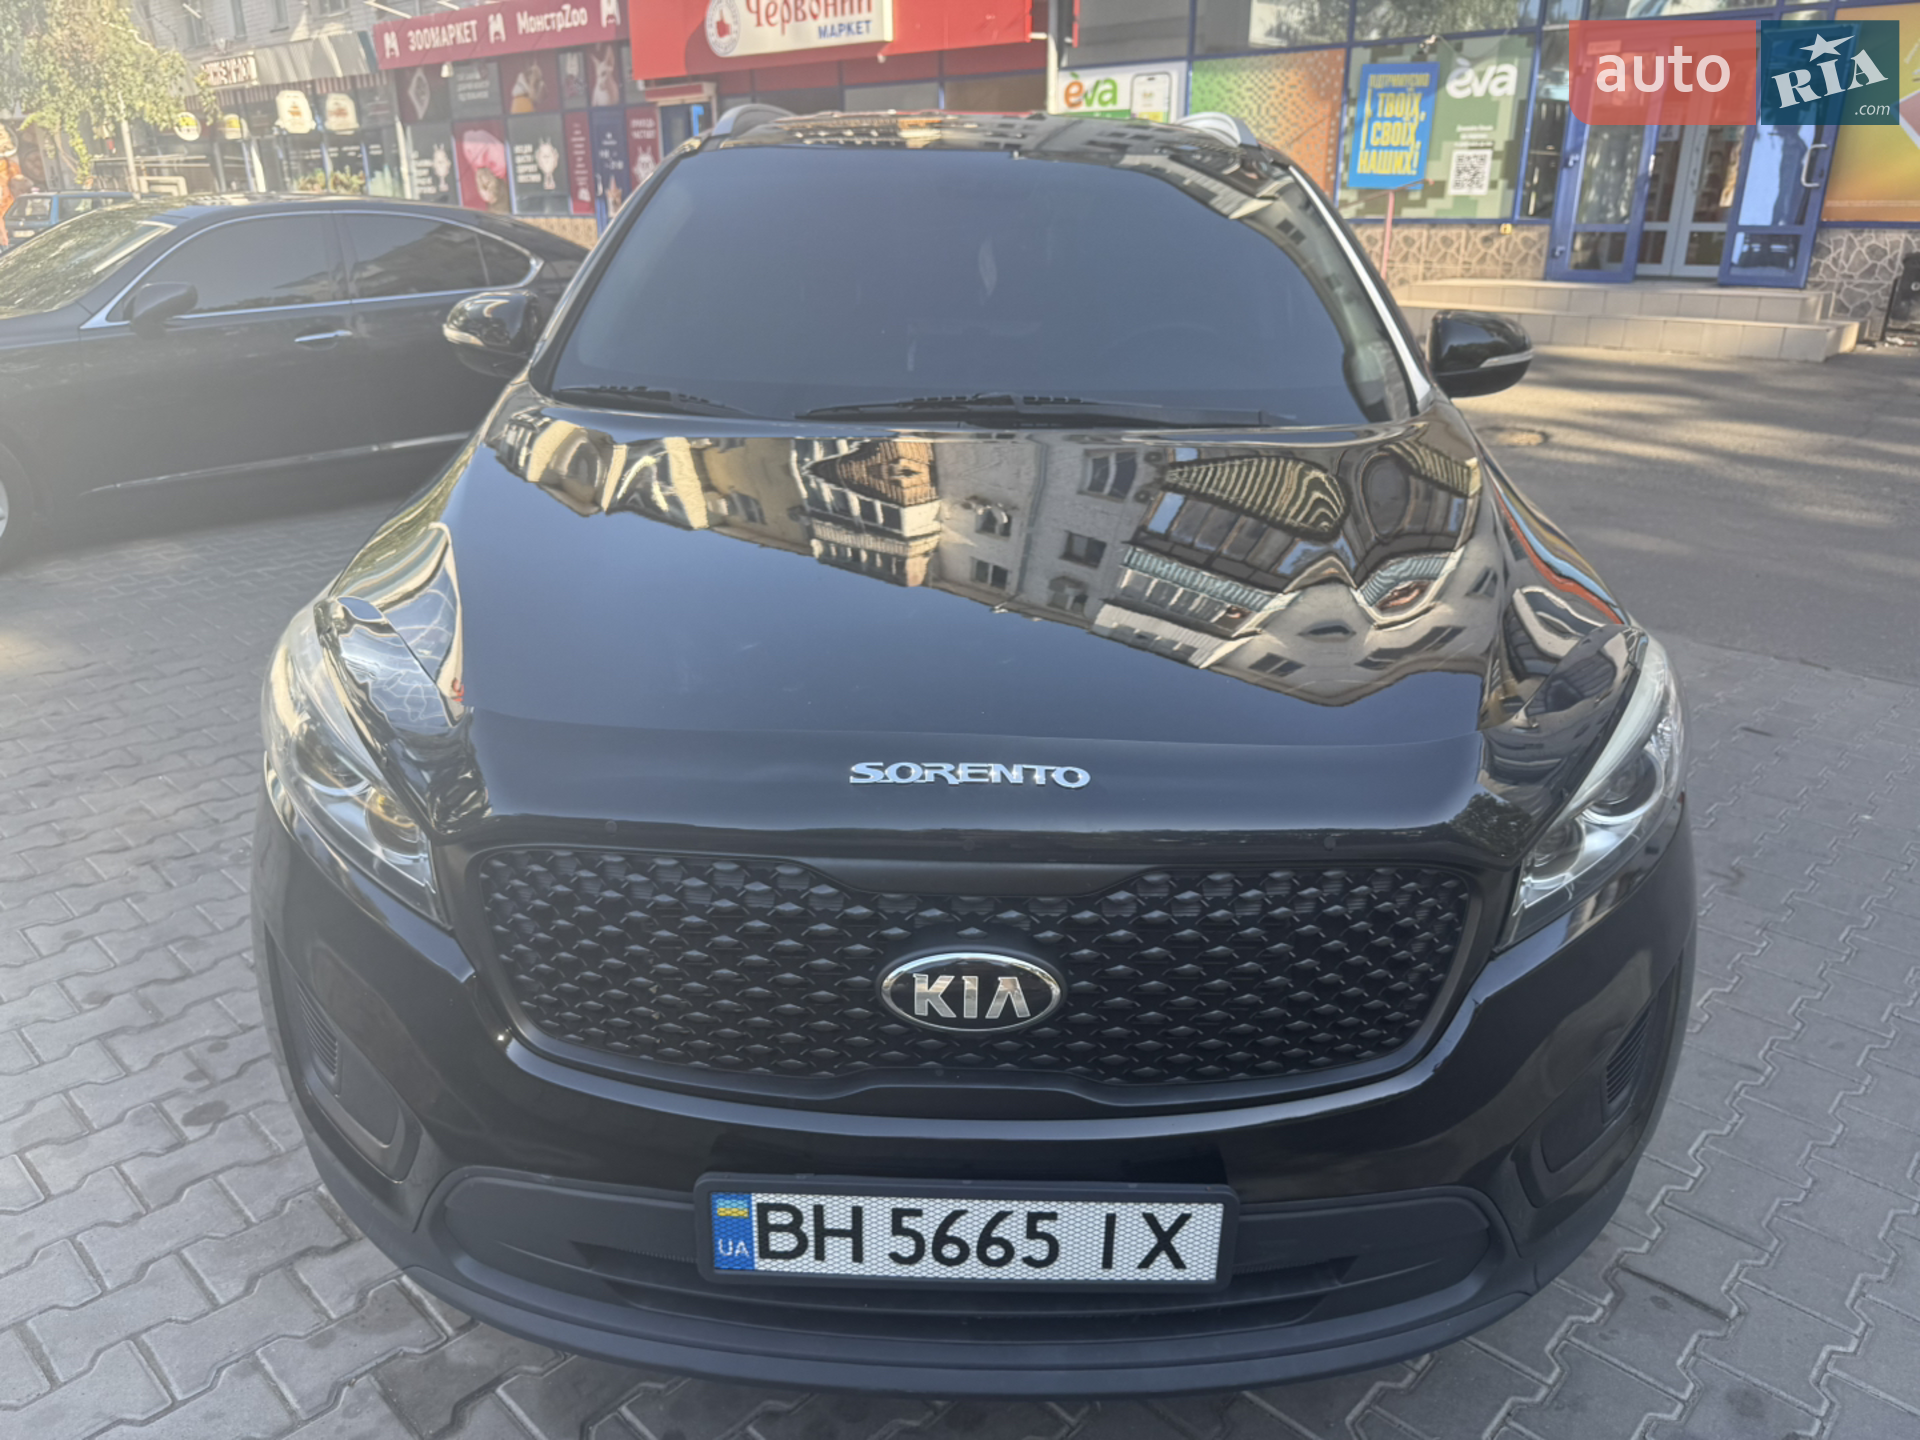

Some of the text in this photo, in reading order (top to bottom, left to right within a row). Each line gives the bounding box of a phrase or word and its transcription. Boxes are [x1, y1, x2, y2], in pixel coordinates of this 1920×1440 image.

[407, 20, 478, 51] ЗООМАРКЕТ
[516, 4, 588, 34] МонстрZoo
[818, 20, 873, 39] МАРКЕТ
[1357, 149, 1421, 175] НАШИХ!
[849, 762, 1090, 788] SORENTO
[913, 972, 1031, 1019] KIA
[718, 1238, 750, 1257] UA
[755, 1202, 1192, 1270] BH 5665 IX
